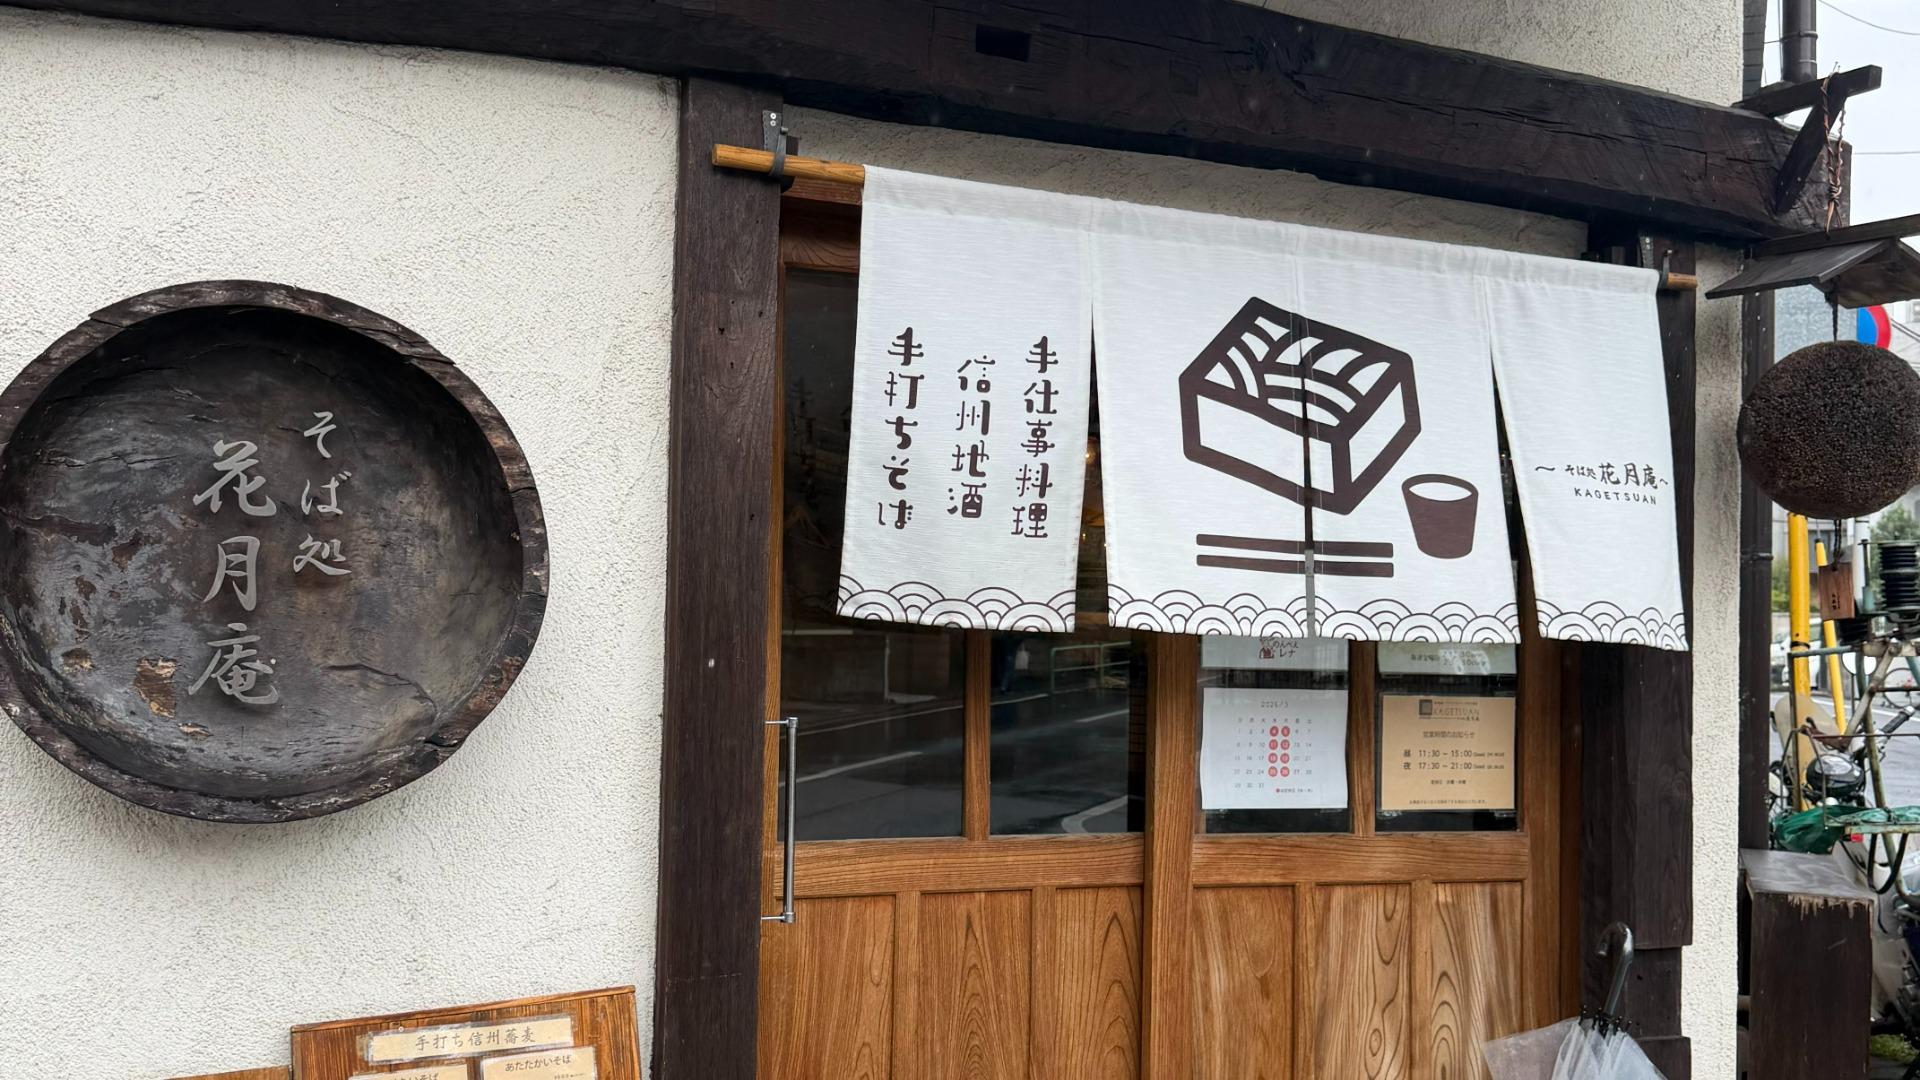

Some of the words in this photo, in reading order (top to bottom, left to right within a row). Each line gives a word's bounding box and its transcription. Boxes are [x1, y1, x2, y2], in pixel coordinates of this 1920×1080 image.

[293, 411, 352, 575] そば処
[878, 327, 925, 530] 手打ちそば
[947, 355, 996, 519] 信州地酒
[1011, 336, 1060, 538] 手仕事料理
[1573, 487, 1657, 505] KAGETSUAN
[188, 439, 279, 705] 花月庵
[415, 1026, 536, 1051] 手打ち信州蕎麦
[505, 1055, 572, 1072] あたたかいそば
